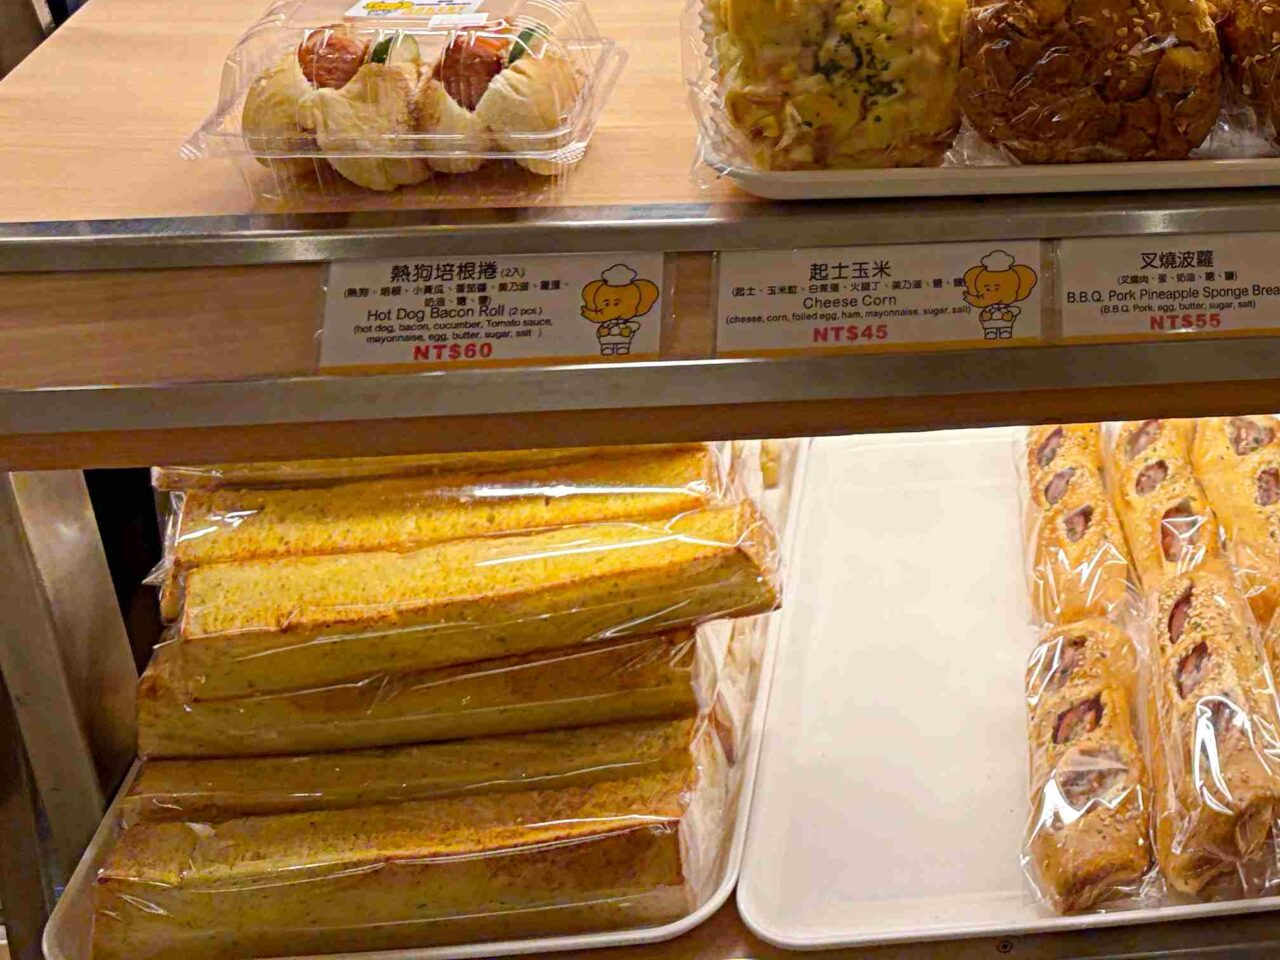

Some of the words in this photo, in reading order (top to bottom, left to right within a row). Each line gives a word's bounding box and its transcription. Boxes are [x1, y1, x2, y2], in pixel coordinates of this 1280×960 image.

[809, 260, 891, 281] 起士玉米
[803, 296, 858, 309] Cheese
[862, 294, 896, 306] Corn
[1067, 291, 1104, 303] B.B.Q.
[1109, 290, 1135, 302] Pork
[1140, 289, 1199, 303] Pineapple
[1203, 286, 1248, 300] Sponge
[368, 309, 391, 321] Hot
[396, 307, 425, 322] Dog
[431, 306, 473, 318] Bacon
[478, 305, 505, 317] Roll
[1238, 300, 1256, 310] salt)
[841, 309, 863, 320] ham,
[1150, 313, 1221, 330] NT$55
[354, 324, 372, 335] (hot
[487, 319, 520, 328] Tomato
[813, 324, 888, 342] NT$45
[413, 342, 493, 360] NT$60
